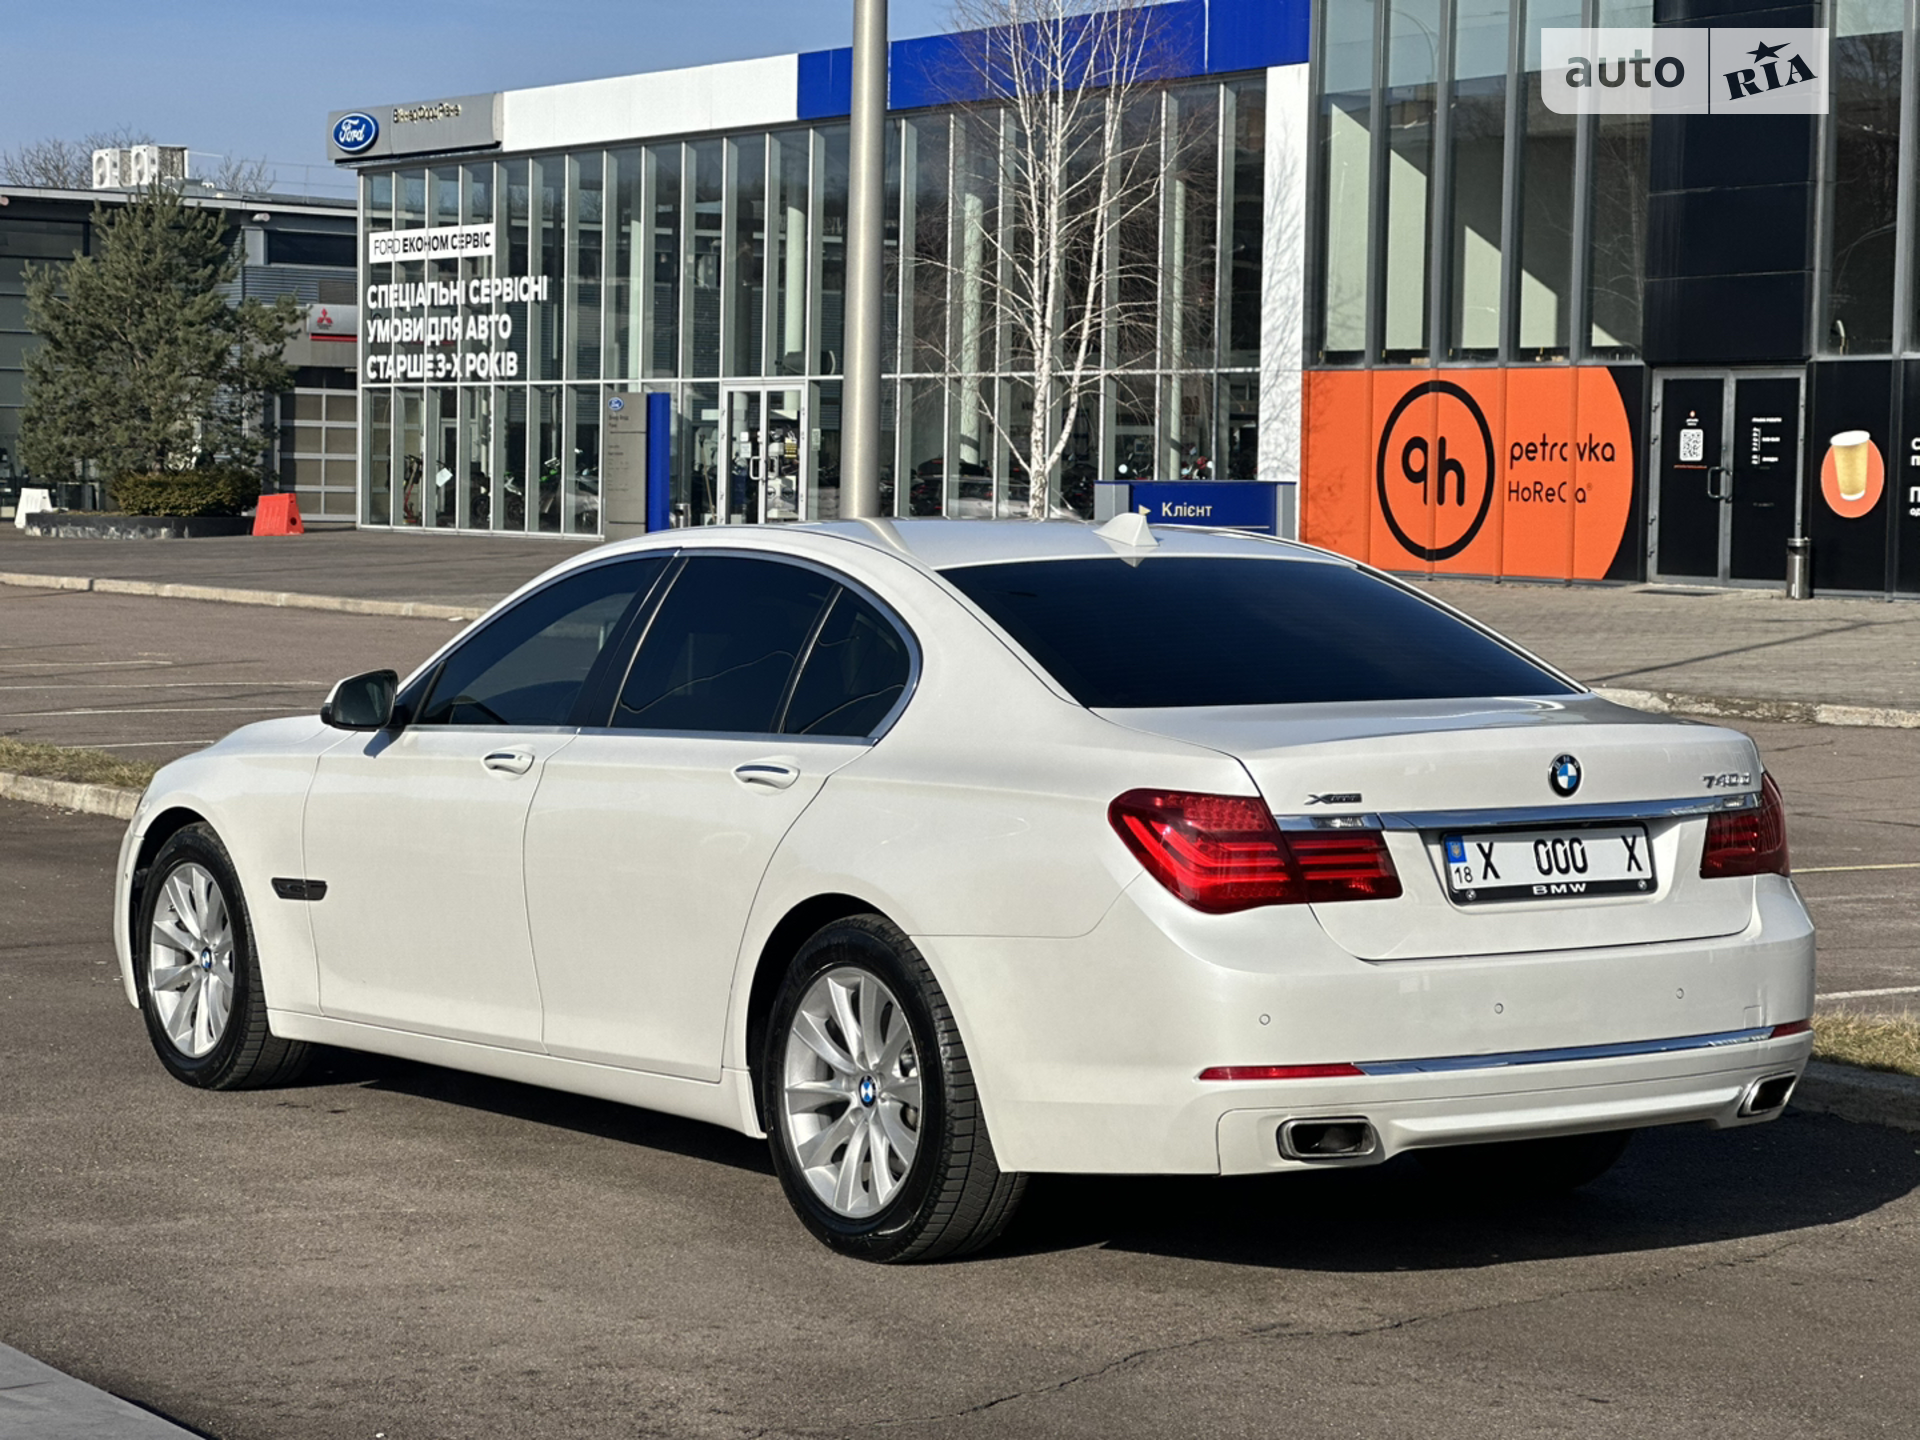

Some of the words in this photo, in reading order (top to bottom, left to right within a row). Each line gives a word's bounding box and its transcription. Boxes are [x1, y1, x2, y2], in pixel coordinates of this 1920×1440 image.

[338, 119, 366, 143] Ford
[374, 238, 401, 256] FORD
[402, 234, 449, 253] ЕКОНОМ
[450, 231, 491, 250] СЕРВІС
[468, 275, 548, 304] СЕРВІСНІ
[366, 317, 424, 343] УМОВИ
[427, 316, 463, 346] ДЛЯ
[465, 313, 512, 340] АВТО
[366, 353, 434, 379] СТАРШЕ
[465, 351, 518, 378] РОКІВ
[1161, 502, 1213, 517] Клієнт
[1533, 837, 1588, 876] 000
[1454, 866, 1474, 884] 18
[1532, 883, 1587, 895] BMW
